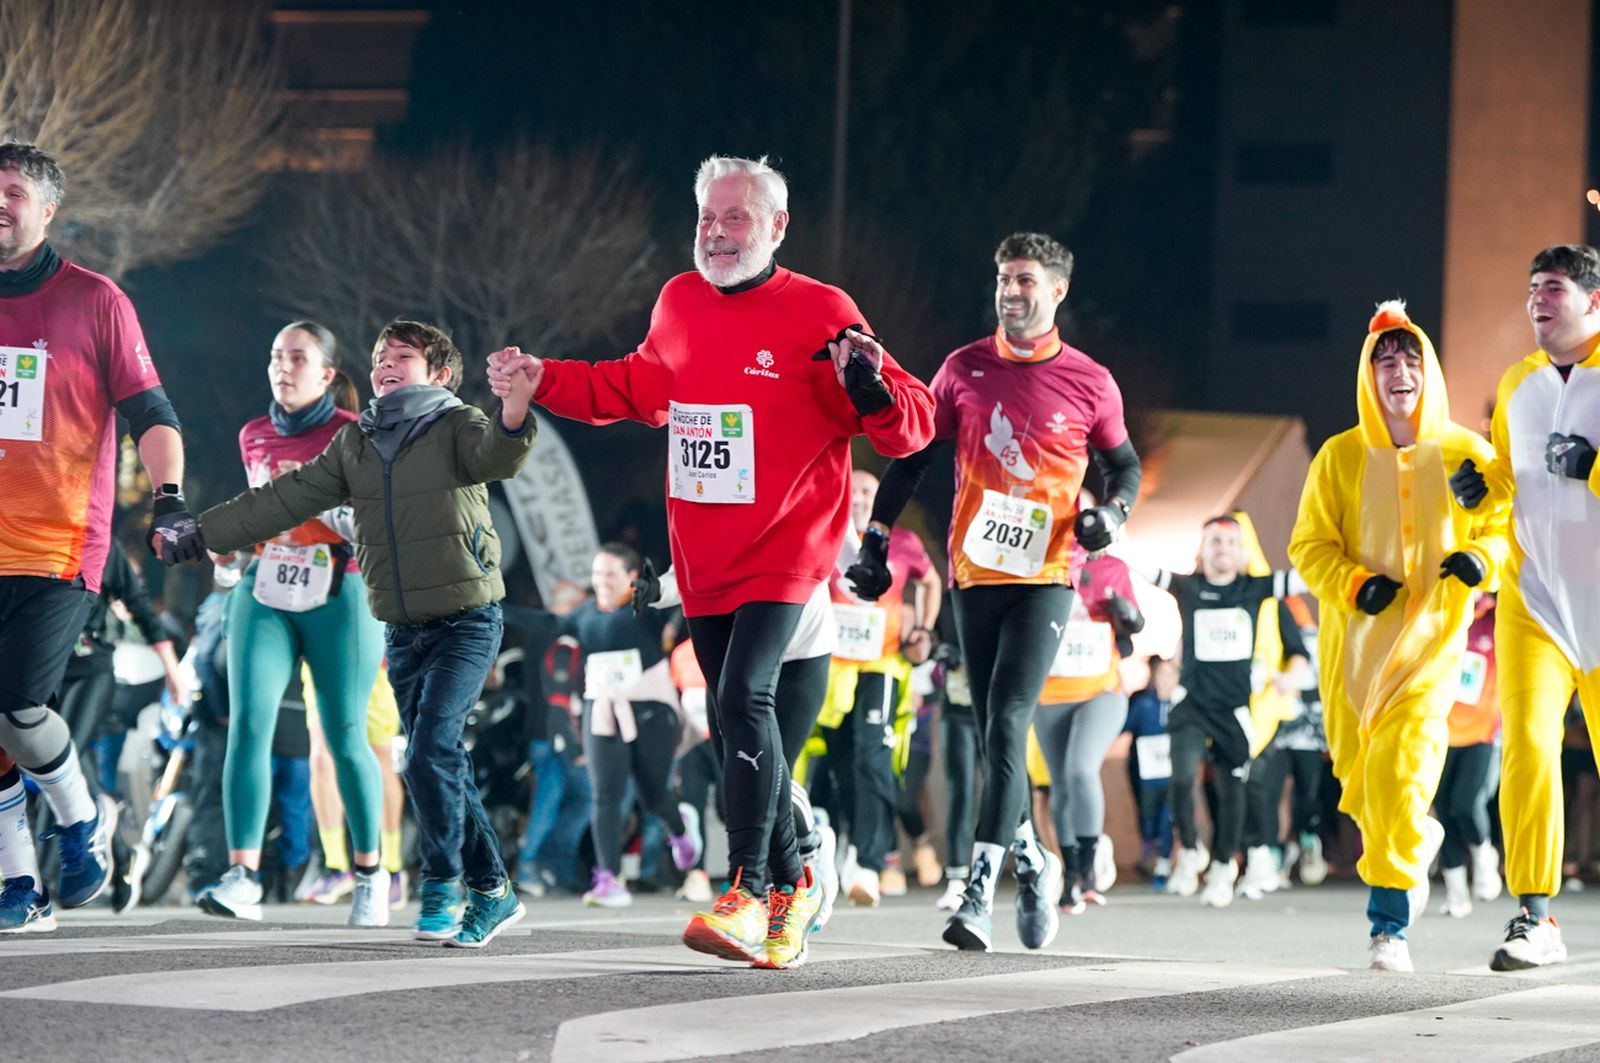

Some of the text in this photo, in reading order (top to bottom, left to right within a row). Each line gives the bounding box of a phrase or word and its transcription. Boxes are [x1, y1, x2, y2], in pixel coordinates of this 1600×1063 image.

[744, 366, 780, 379] Cáritas
[677, 415, 712, 425] NOCHE DE
[673, 425, 685, 436] SAN
[686, 425, 712, 438] ANTÓN
[681, 438, 731, 469] 3125
[999, 445, 1019, 467] 43
[982, 519, 1034, 550] 2037
[277, 564, 310, 587] 824
